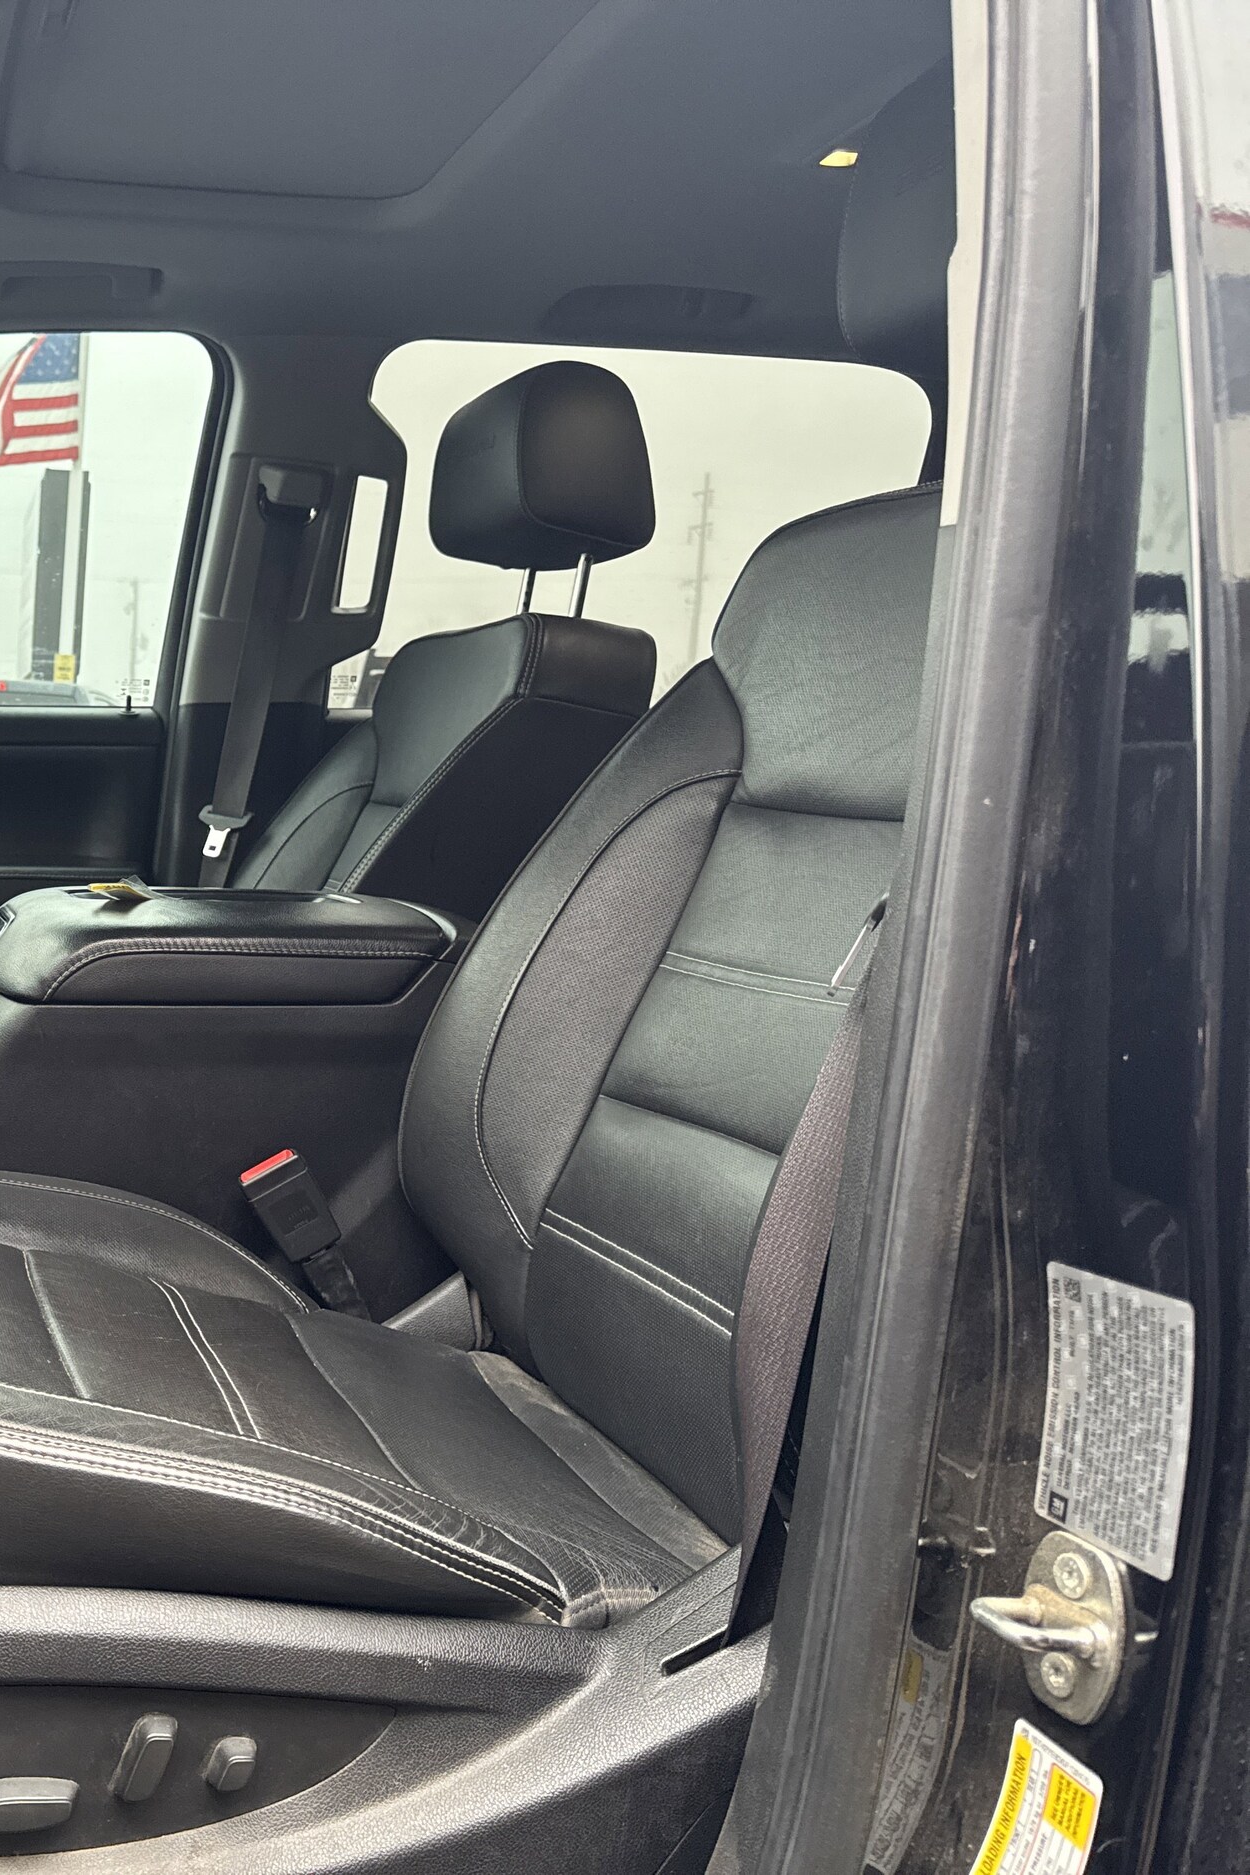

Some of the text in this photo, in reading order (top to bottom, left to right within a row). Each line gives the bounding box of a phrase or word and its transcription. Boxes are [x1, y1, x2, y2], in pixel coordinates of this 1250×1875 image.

[1038, 1278, 1061, 1510] VEHICLE NOISE EMISSION CONTROL INFORMATION
[998, 1753, 1027, 1830] INFORMATION
